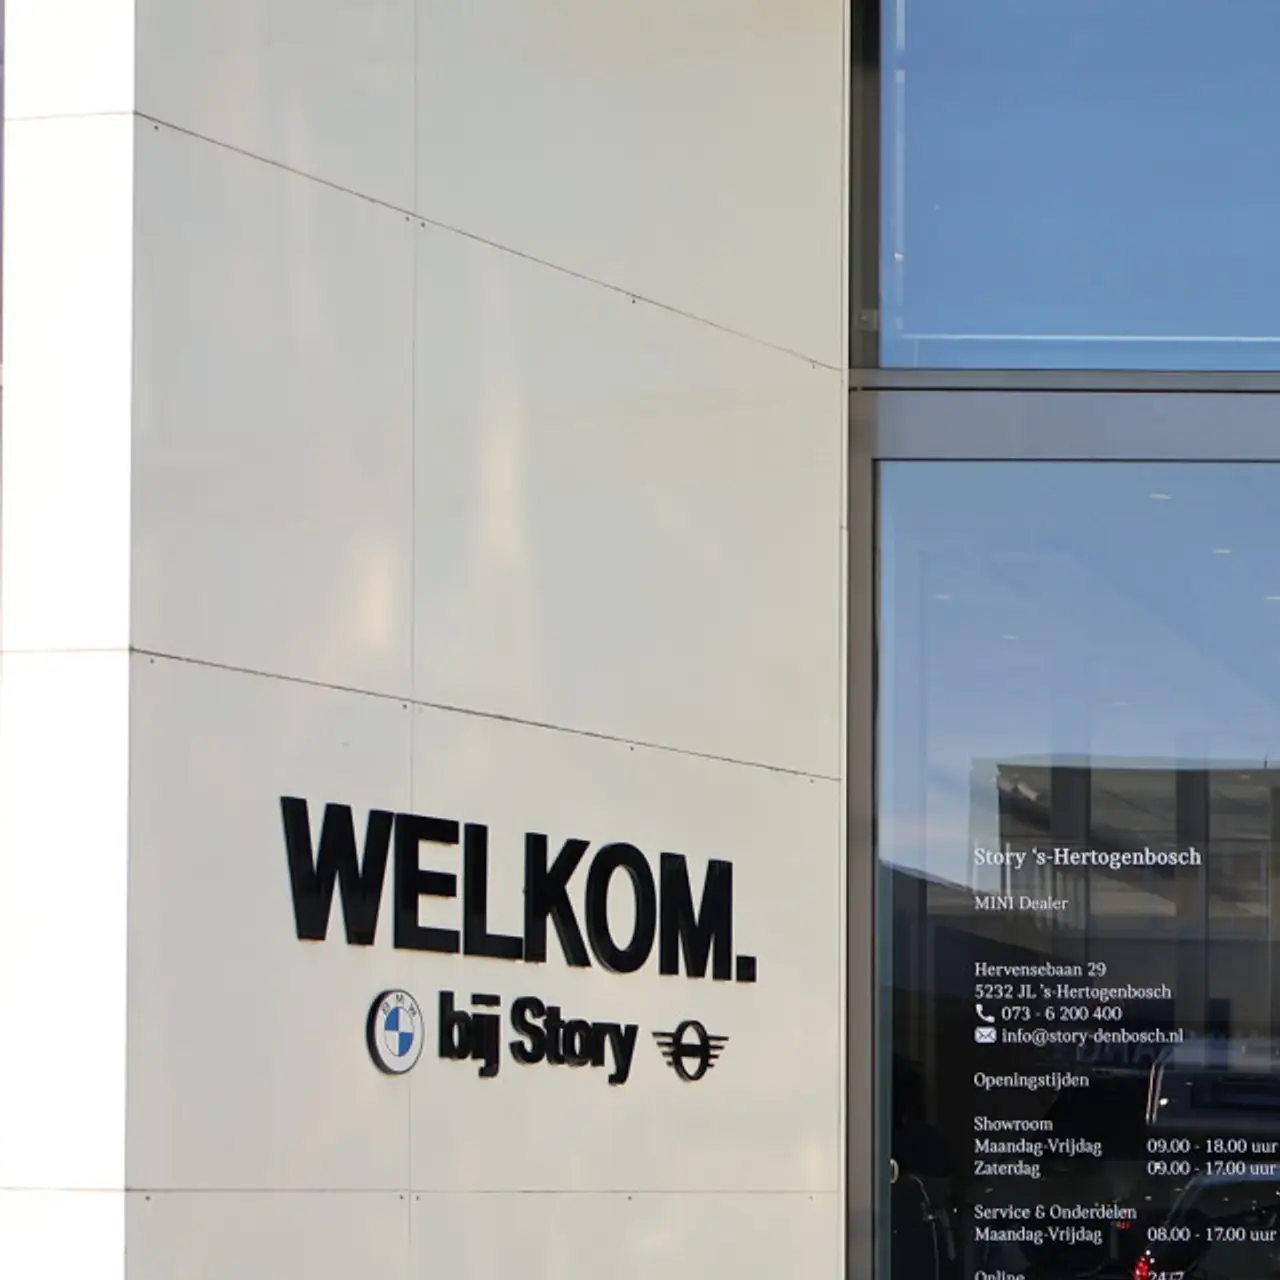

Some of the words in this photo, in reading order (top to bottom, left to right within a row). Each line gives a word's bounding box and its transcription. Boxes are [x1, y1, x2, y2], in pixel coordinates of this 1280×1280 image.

[974, 847, 1026, 869] Story
[280, 796, 757, 983] WELKOM.
[975, 895, 1014, 911] MINI
[1019, 895, 1068, 911] Dealer
[974, 962, 1082, 977] Hervensebaan
[1087, 962, 1106, 977] 29
[975, 984, 1013, 999] 5232
[1017, 984, 1036, 1000] JL
[1001, 1006, 1031, 1021] 073
[1045, 1006, 1056, 1021] 6
[1060, 1006, 1089, 1021] 200
[1092, 1006, 1122, 1021] 400
[438, 990, 501, 1078] bij
[509, 996, 639, 1085] Story
[1002, 1028, 1183, 1046] info@story-denbosch.nl
[974, 1072, 1089, 1090] Openingstijden
[974, 1116, 1053, 1131] Showroom
[974, 1138, 1102, 1156] Maandag-Vrijdag
[1147, 1139, 1191, 1154] 09.00
[1205, 1139, 1248, 1154] 18.00
[1251, 1141, 1279, 1154] uur
[974, 1160, 1041, 1179] Zaterdag
[1147, 1160, 1191, 1176] 09.00
[1205, 1160, 1246, 1176] 17.00
[1249, 1163, 1276, 1176] uur
[974, 1204, 1031, 1220] Service
[1049, 1203, 1137, 1220] Onderdelen
[974, 1227, 1102, 1245] Maandag-Vrijdag
[1147, 1227, 1191, 1242] 08.00
[1205, 1227, 1246, 1242] 17.00
[1249, 1229, 1277, 1242] uur
